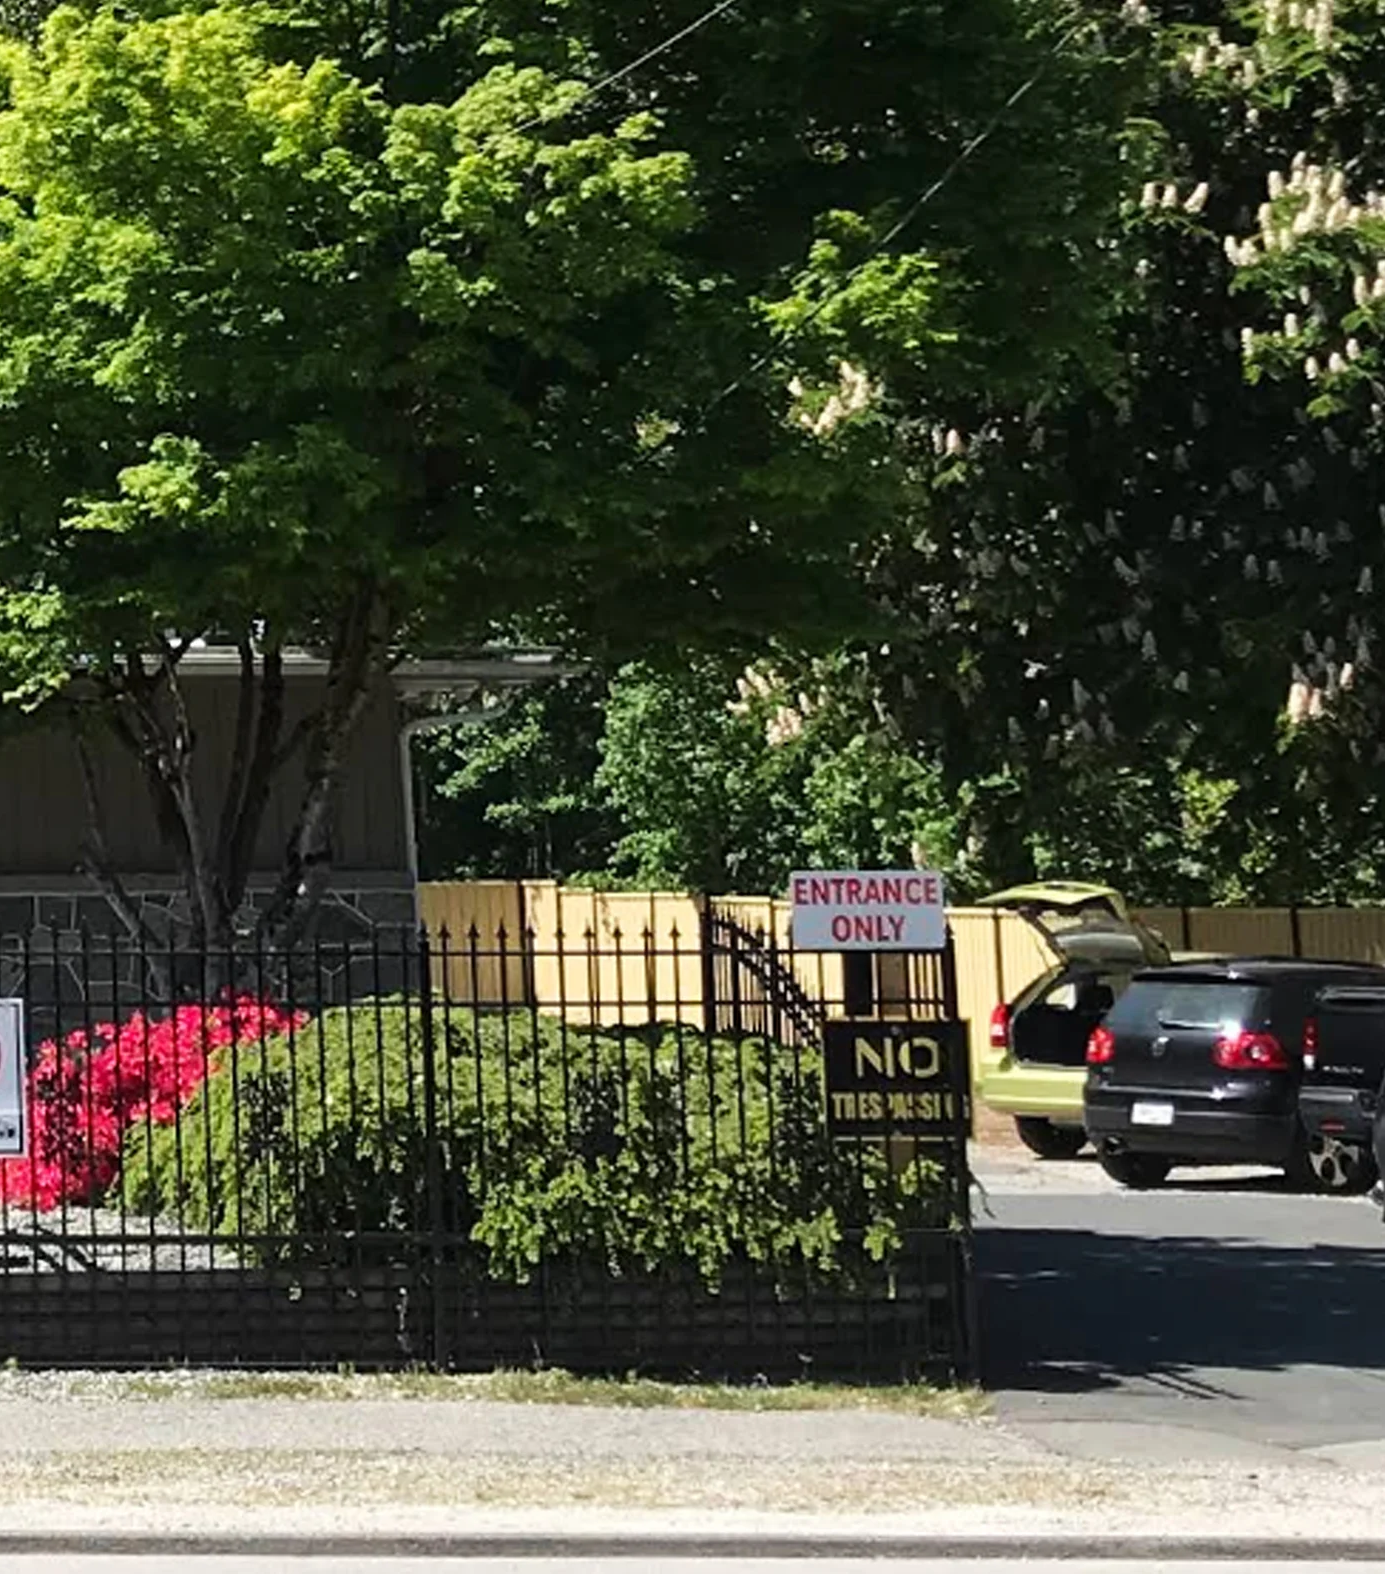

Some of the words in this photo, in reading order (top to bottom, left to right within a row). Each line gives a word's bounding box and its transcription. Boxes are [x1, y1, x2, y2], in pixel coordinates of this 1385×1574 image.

[793, 878, 938, 905] ENTRANCE
[831, 914, 906, 942] ONLY
[853, 1036, 939, 1079] NO
